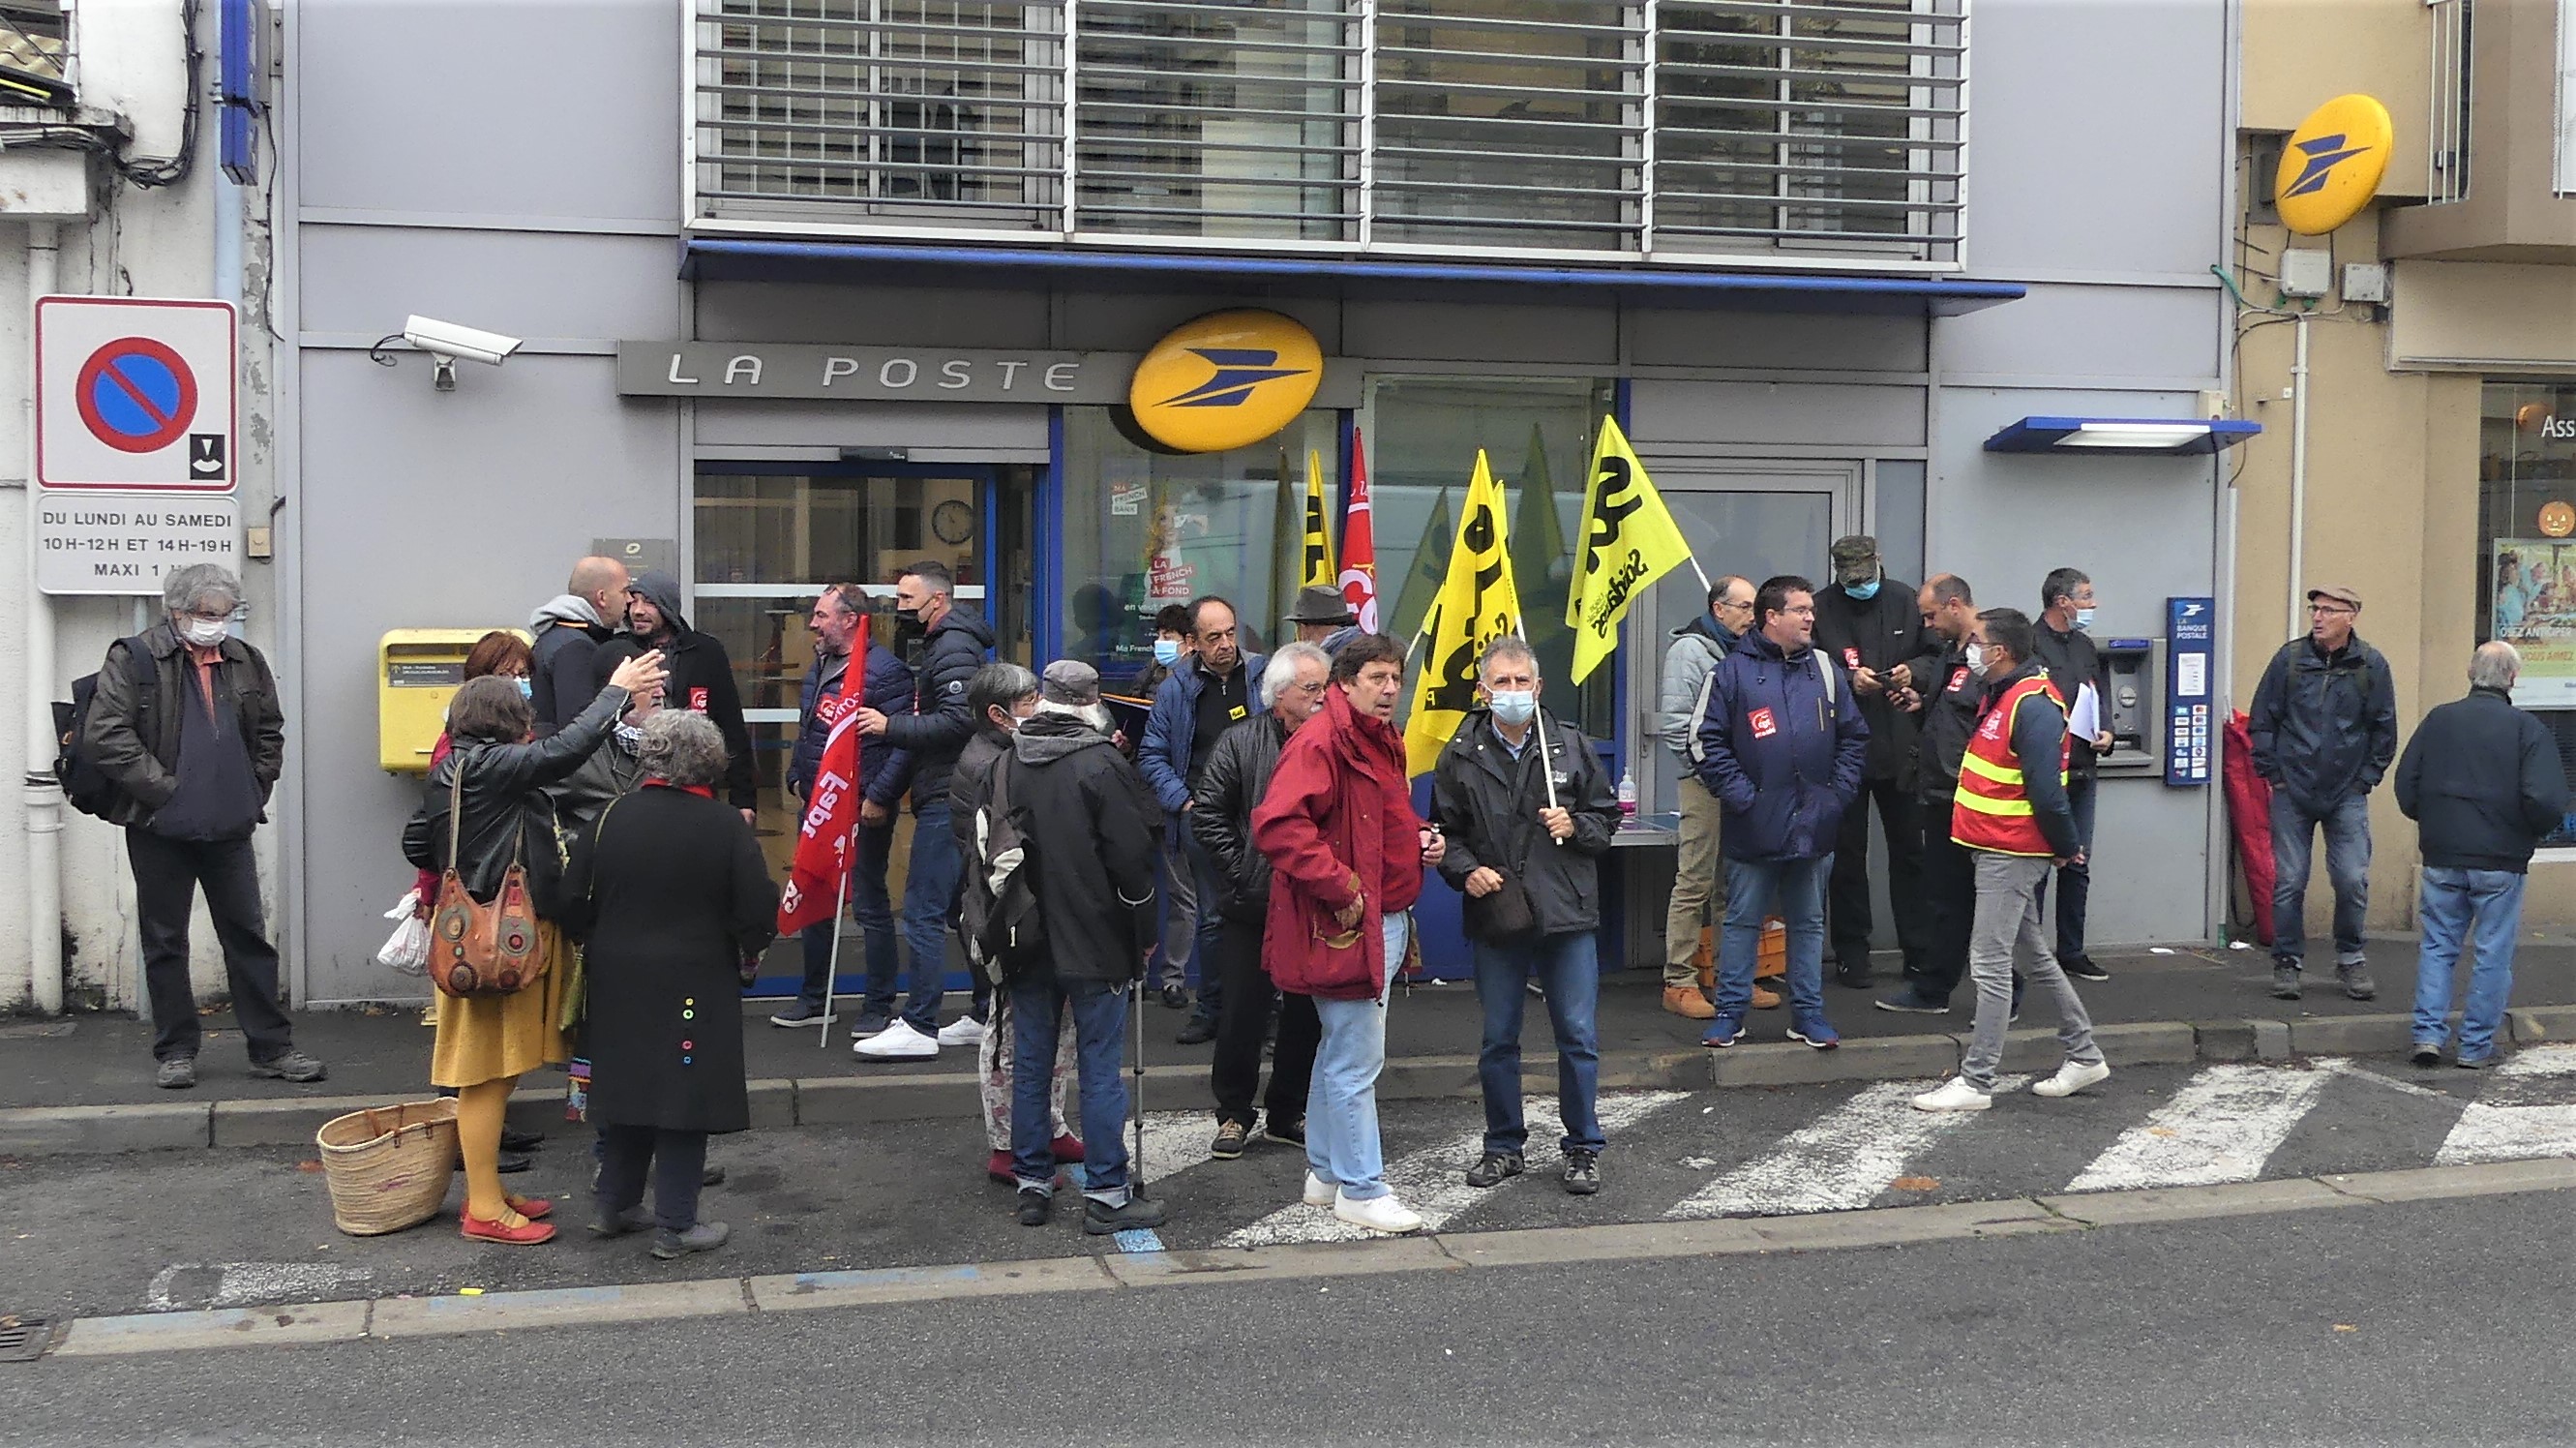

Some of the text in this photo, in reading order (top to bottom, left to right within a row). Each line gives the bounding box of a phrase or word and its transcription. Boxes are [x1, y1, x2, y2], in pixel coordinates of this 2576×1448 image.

[669, 353, 1081, 391] LA POSTE
[43, 512, 231, 528] DU LUNDI AU SAMEDI
[127, 538, 150, 552] ET
[94, 563, 139, 577] MAXI
[152, 564, 160, 577] 1
[1153, 560, 1167, 569] LA
[1153, 566, 1193, 585] FRENCH
[1161, 586, 1190, 595] FOND
